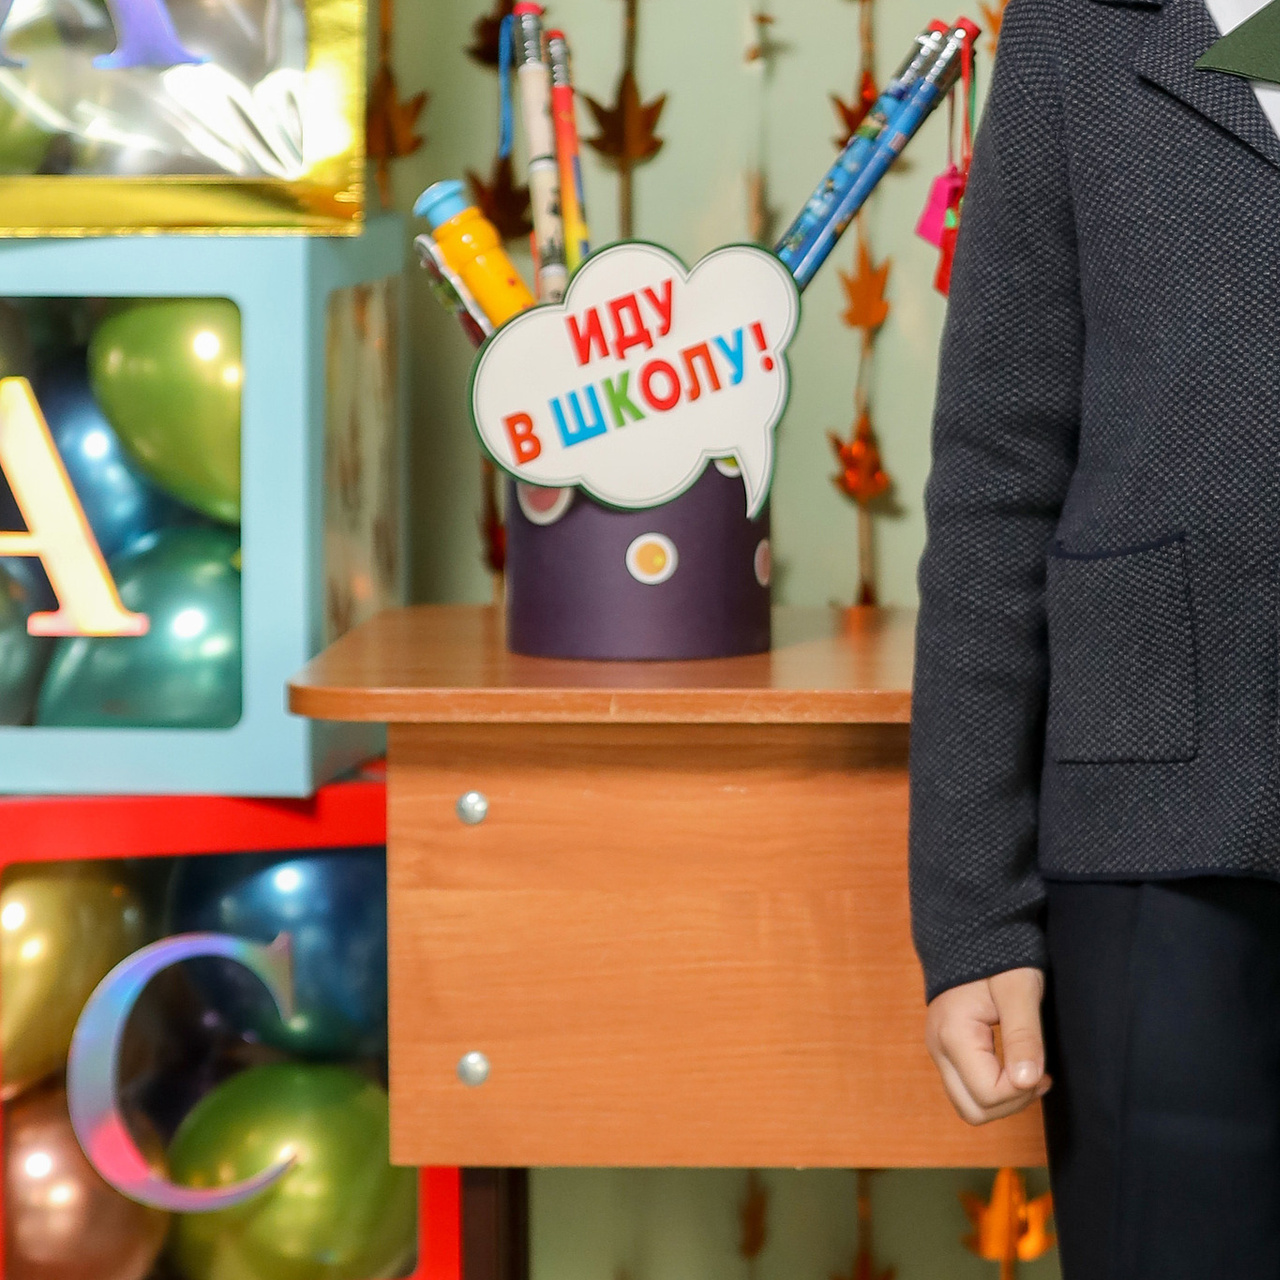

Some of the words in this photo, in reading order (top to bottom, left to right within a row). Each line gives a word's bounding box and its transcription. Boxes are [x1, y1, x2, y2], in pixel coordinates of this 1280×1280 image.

[565, 278, 674, 367] ИДУ
[502, 411, 542, 466] В
[549, 320, 776, 450] ШКОЛУ!
